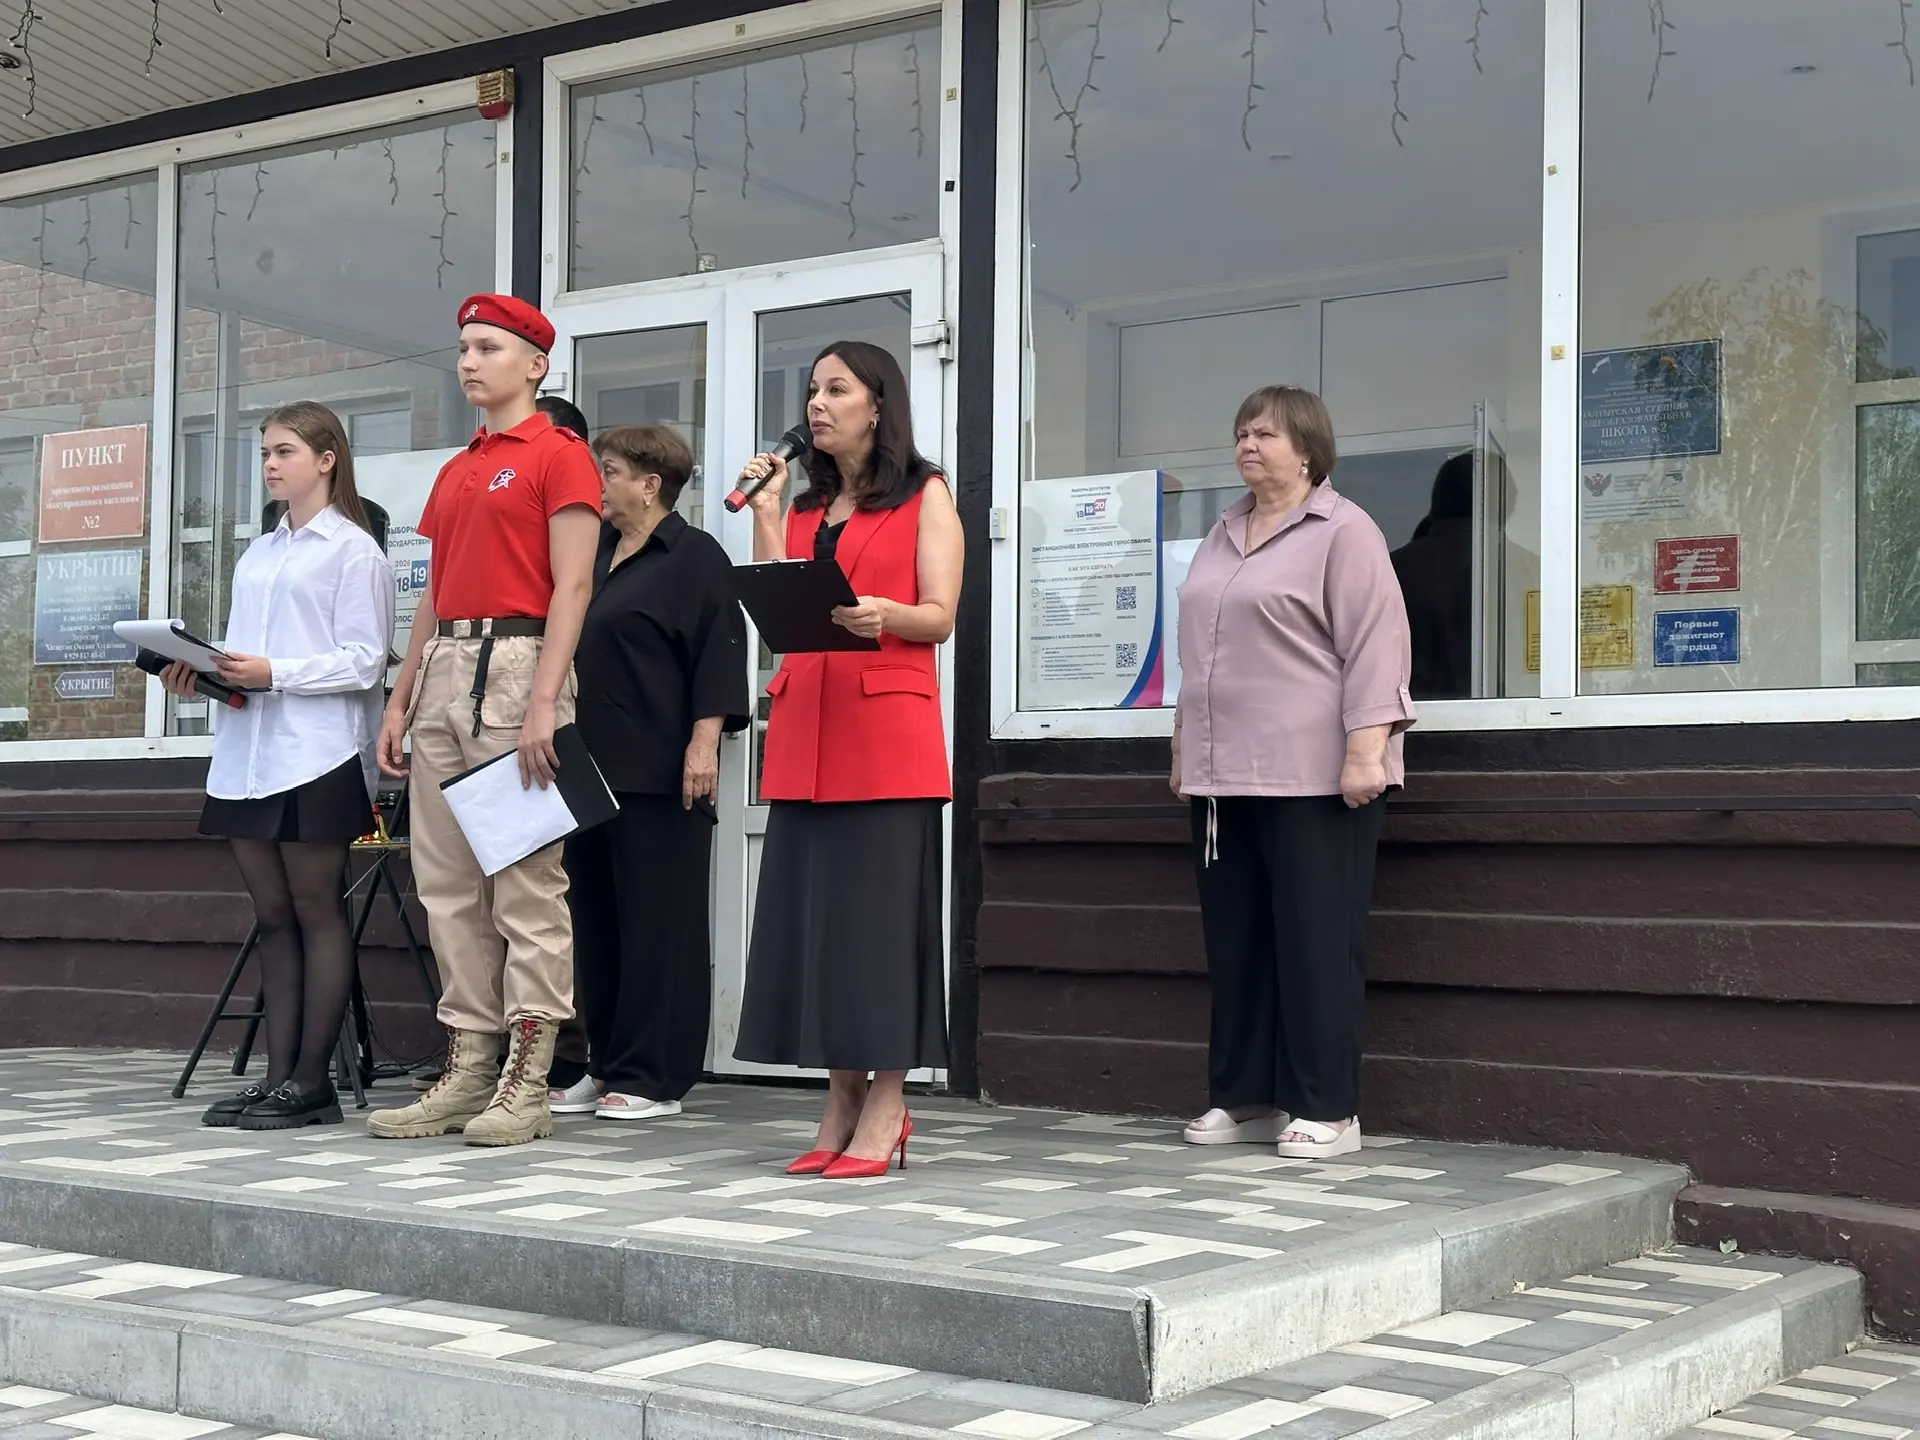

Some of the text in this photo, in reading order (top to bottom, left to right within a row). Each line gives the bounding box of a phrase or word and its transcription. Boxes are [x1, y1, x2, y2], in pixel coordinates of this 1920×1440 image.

[1583, 412, 1692, 428] БЩЕОБРАЗОВАТЕЛЬНАЯ
[1602, 425, 1647, 438] ШКОЛА
[61, 443, 126, 469] ПУНКТ
[1086, 506, 1094, 514] 19
[82, 515, 100, 530] №2
[46, 556, 137, 580] УКРЫТИЕ
[413, 566, 426, 582] 19
[396, 577, 410, 592] 18
[394, 615, 412, 623] ОЛОС
[1674, 620, 1719, 630] Первые
[1668, 632, 1726, 640] зажигают
[1676, 644, 1717, 652] сердца
[61, 678, 111, 690] УКРЫТИЕ
